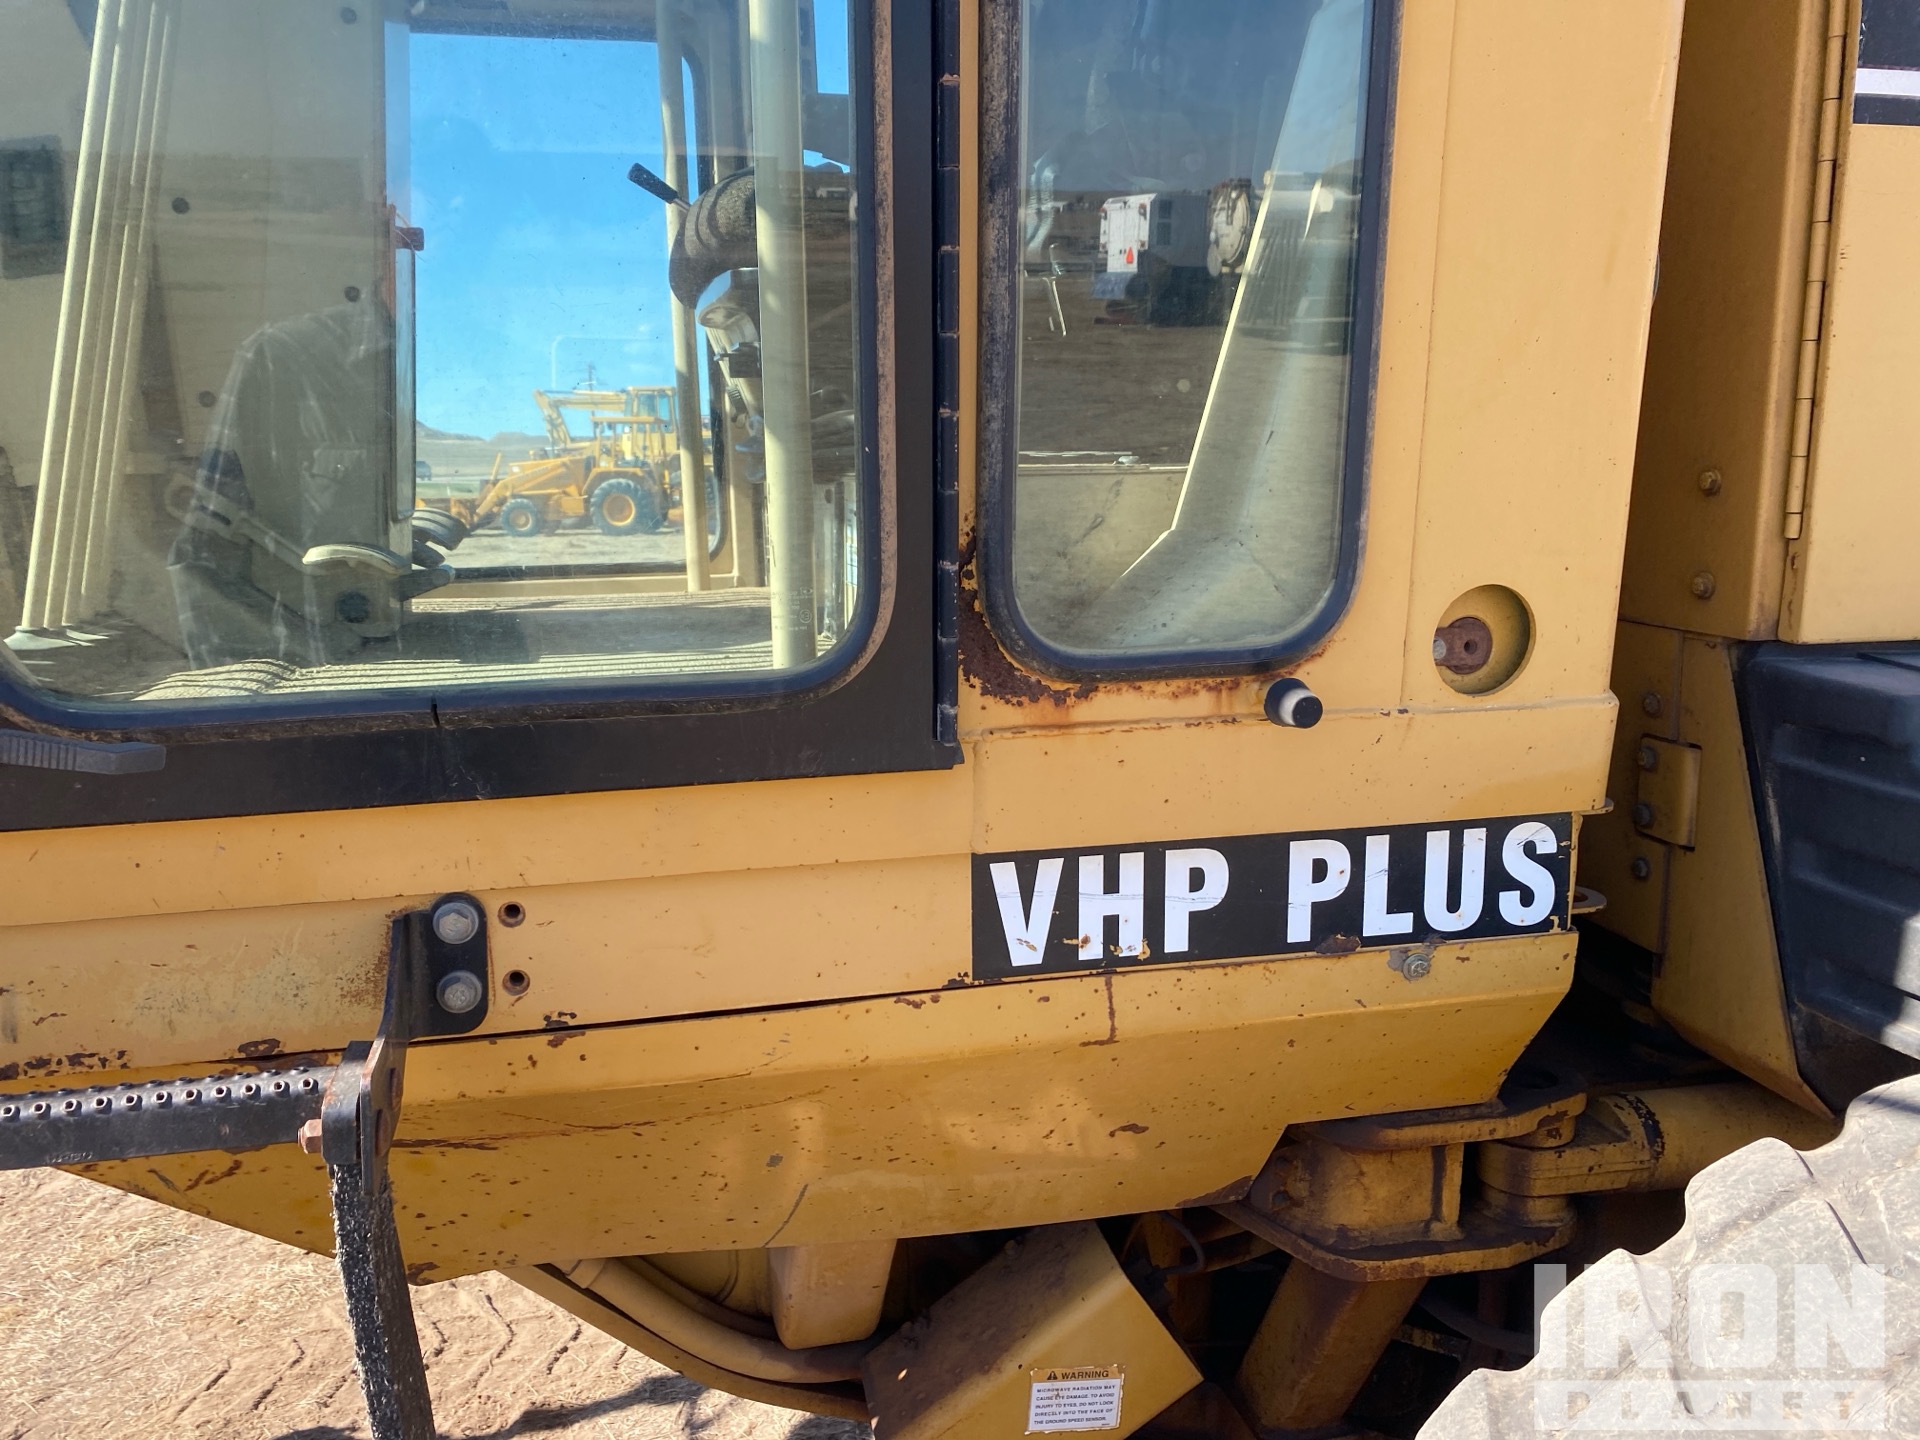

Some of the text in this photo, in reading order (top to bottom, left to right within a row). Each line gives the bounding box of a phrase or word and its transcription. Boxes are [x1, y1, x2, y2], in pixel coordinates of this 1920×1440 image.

[989, 821, 1558, 967] VHP PLUS
[1061, 1370, 1109, 1380] WARNING
